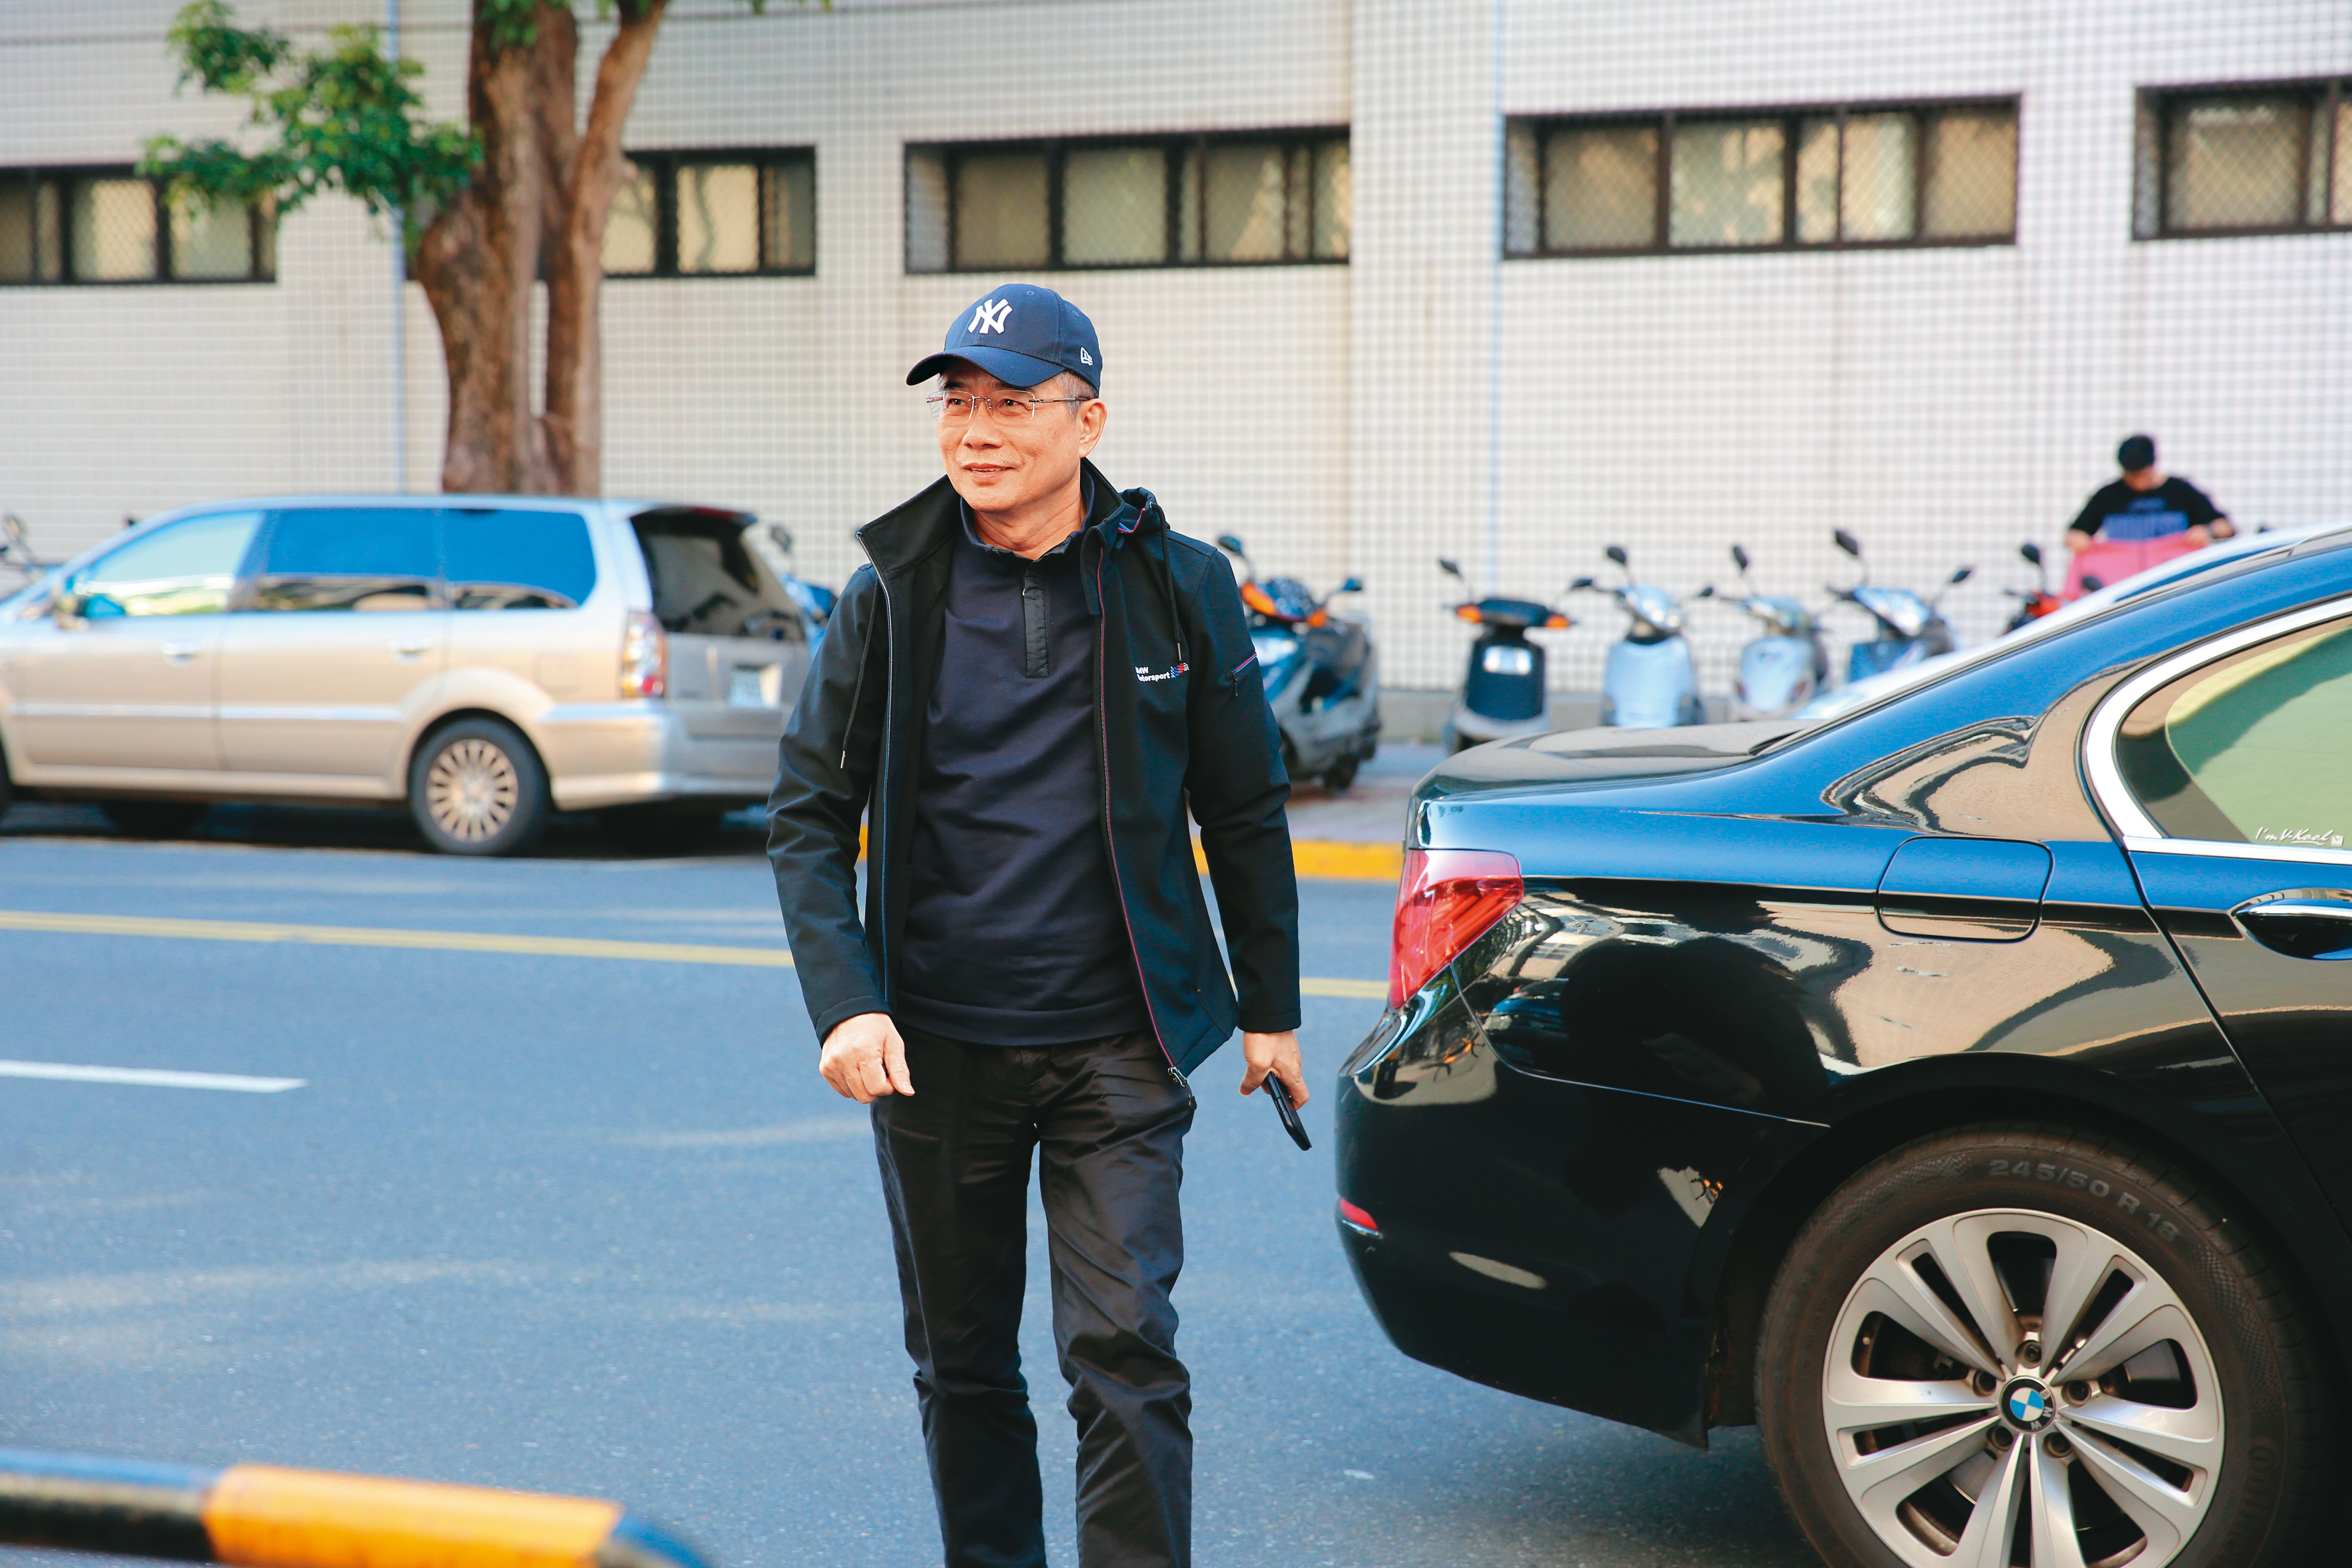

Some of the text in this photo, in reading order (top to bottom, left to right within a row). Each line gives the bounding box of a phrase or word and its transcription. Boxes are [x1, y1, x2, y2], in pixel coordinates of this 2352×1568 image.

[968, 298, 1013, 334] NY
[2255, 827, 2334, 843] I'm V-Kool
[1989, 1158, 2179, 1242] 245/50 R 18
[2031, 1388, 2053, 1430] BMW
